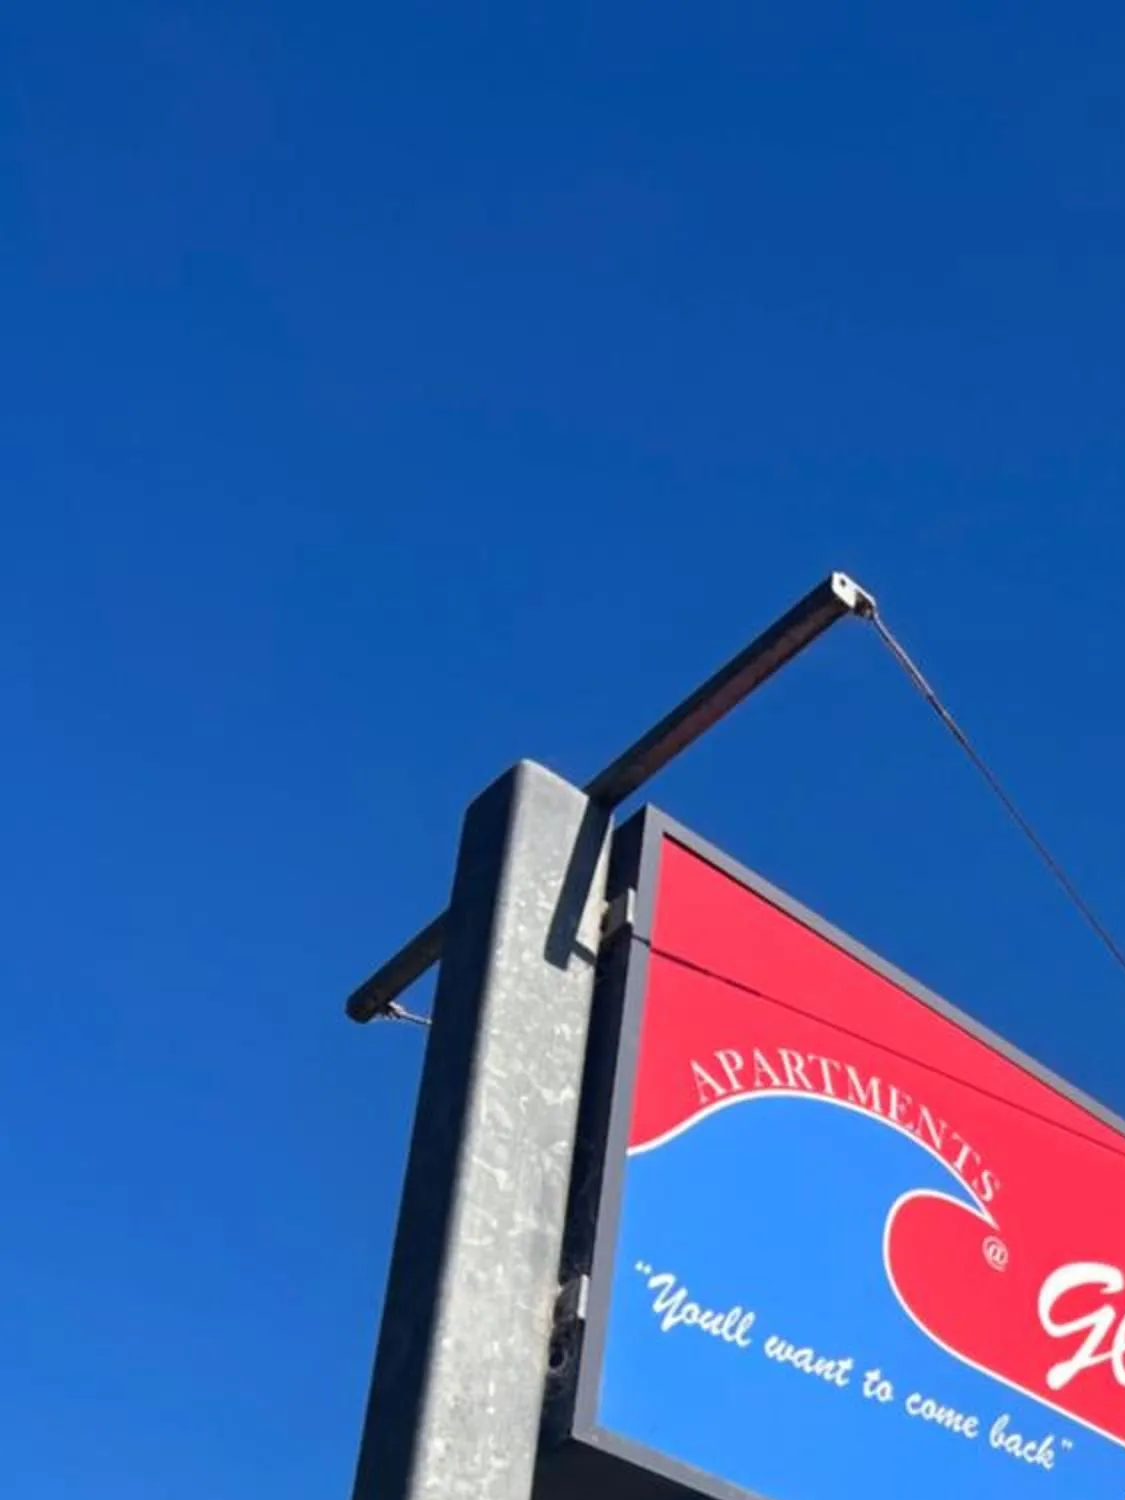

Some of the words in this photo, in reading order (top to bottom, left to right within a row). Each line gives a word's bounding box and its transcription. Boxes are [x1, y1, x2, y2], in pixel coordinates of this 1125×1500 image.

[689, 1047, 1001, 1203] APARTMENTS
[982, 1237, 1009, 1271] @
[765, 1335, 854, 1386] want
[863, 1368, 894, 1403] to
[906, 1393, 979, 1438] come
